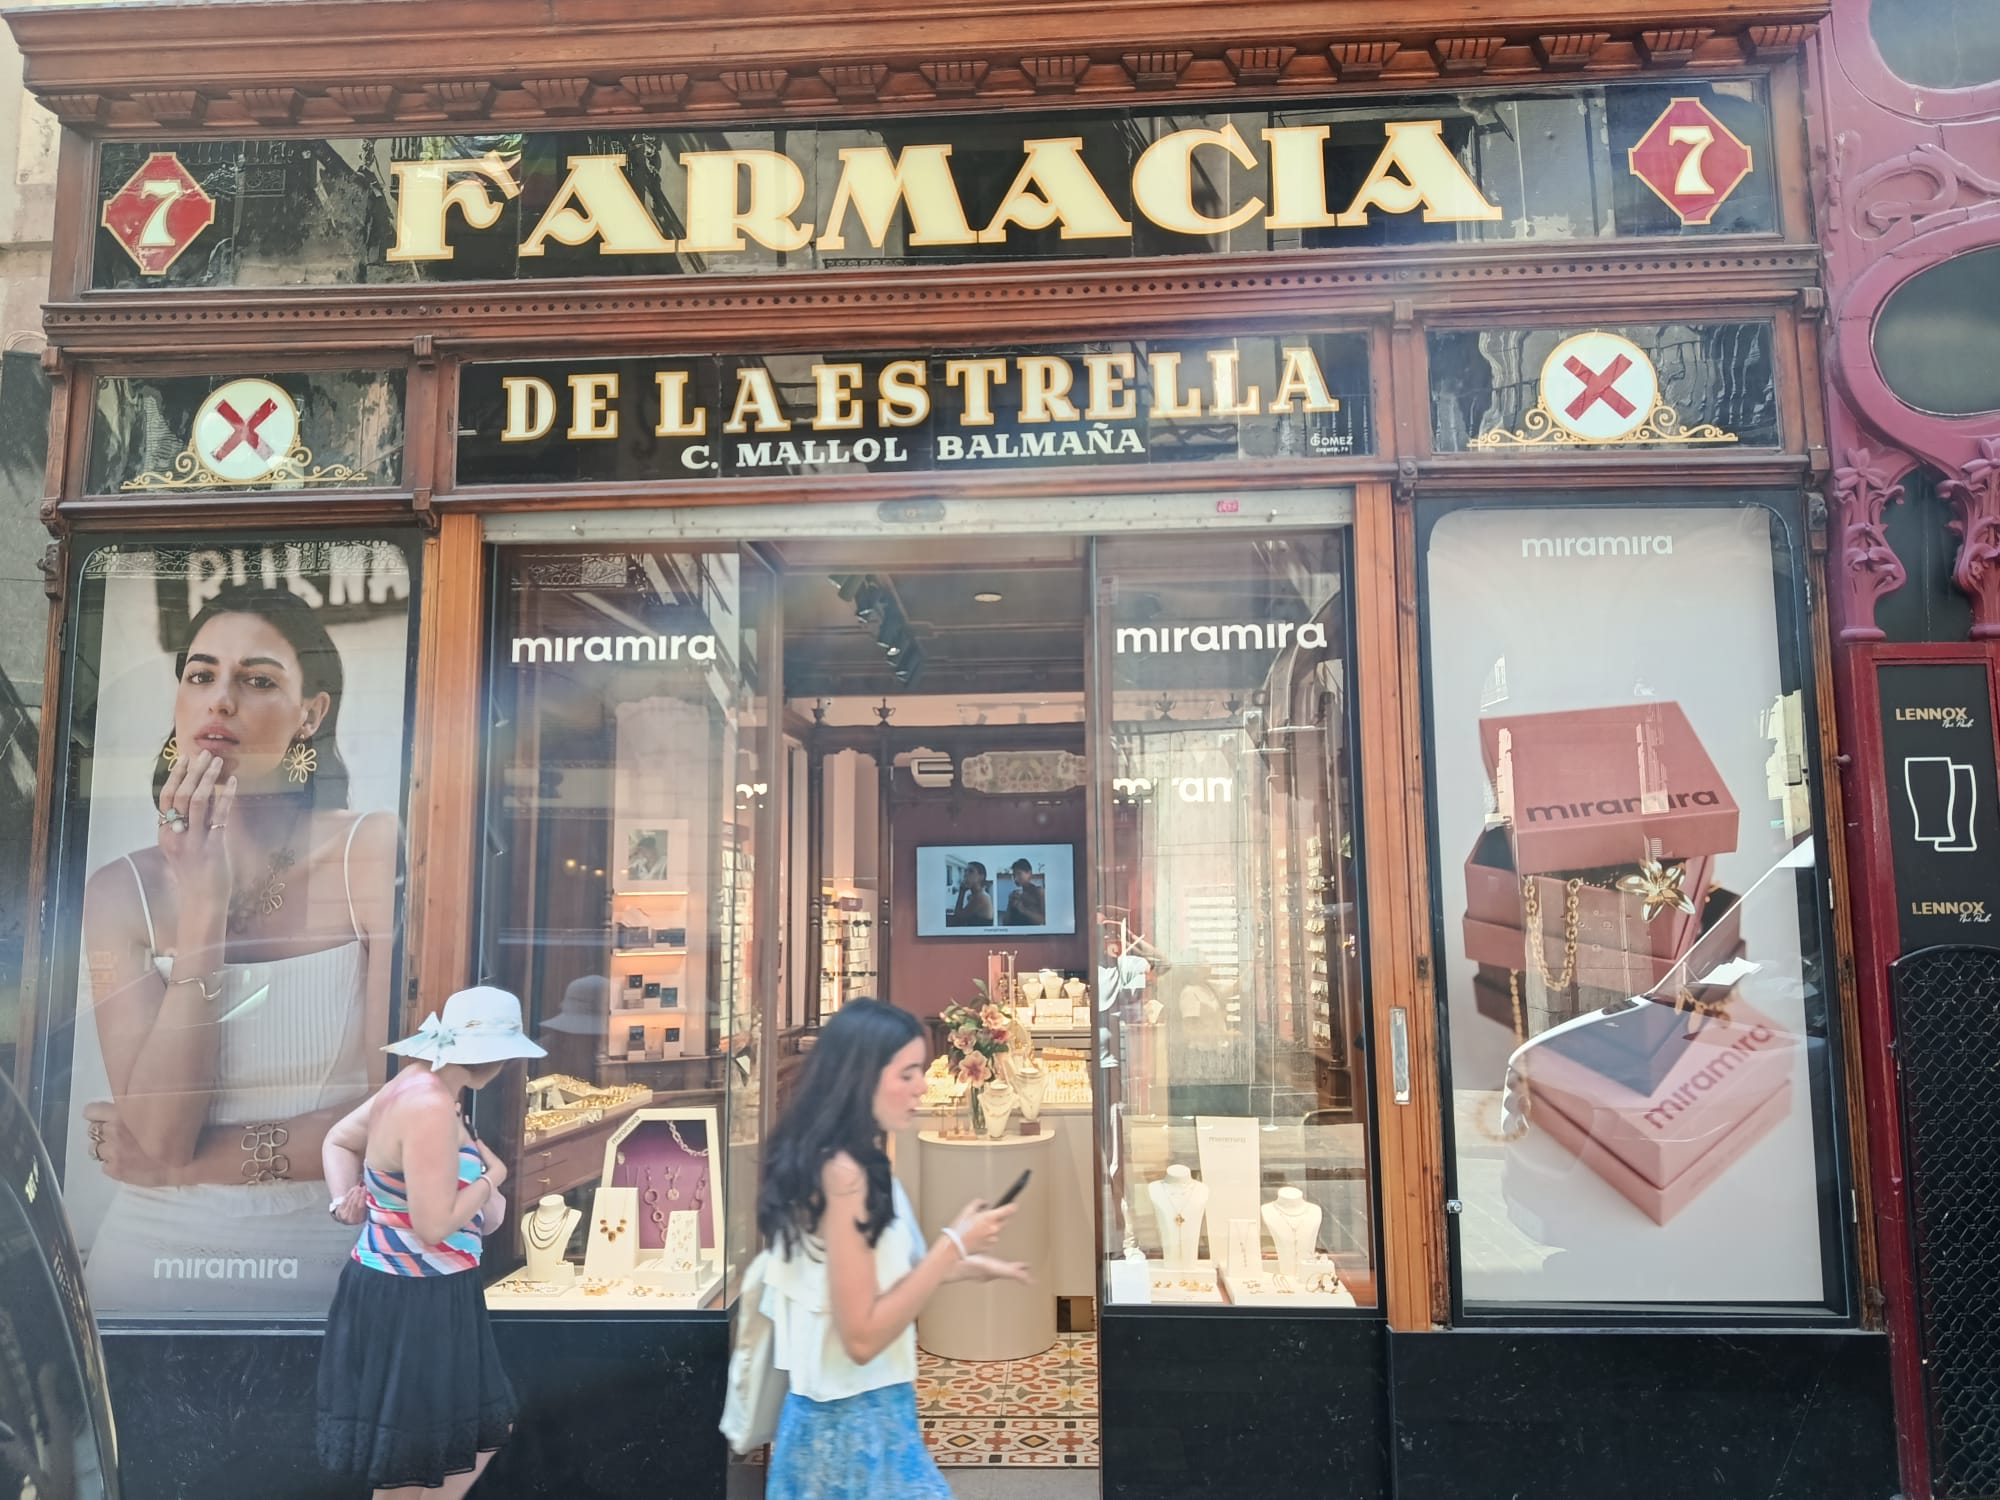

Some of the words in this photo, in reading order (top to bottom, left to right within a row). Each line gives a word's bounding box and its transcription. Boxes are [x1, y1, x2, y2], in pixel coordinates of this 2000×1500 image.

[1668, 124, 1715, 196] 7
[386, 119, 1503, 262] FARMACIA
[502, 372, 620, 442] DE
[655, 366, 791, 437] LA
[811, 346, 1340, 430] ESTRELLA
[680, 444, 718, 471] C.
[735, 436, 908, 468] MALLOL
[936, 422, 1146, 461] BALMAÑA
[1521, 533, 1673, 558] miramira
[511, 633, 717, 663] miramira
[1115, 619, 1328, 653] miramira
[1895, 707, 1968, 721] LENNOX
[1911, 901, 1985, 915] LENNOX
[1643, 1024, 1774, 1131] miramira
[153, 1254, 298, 1281] miramira
